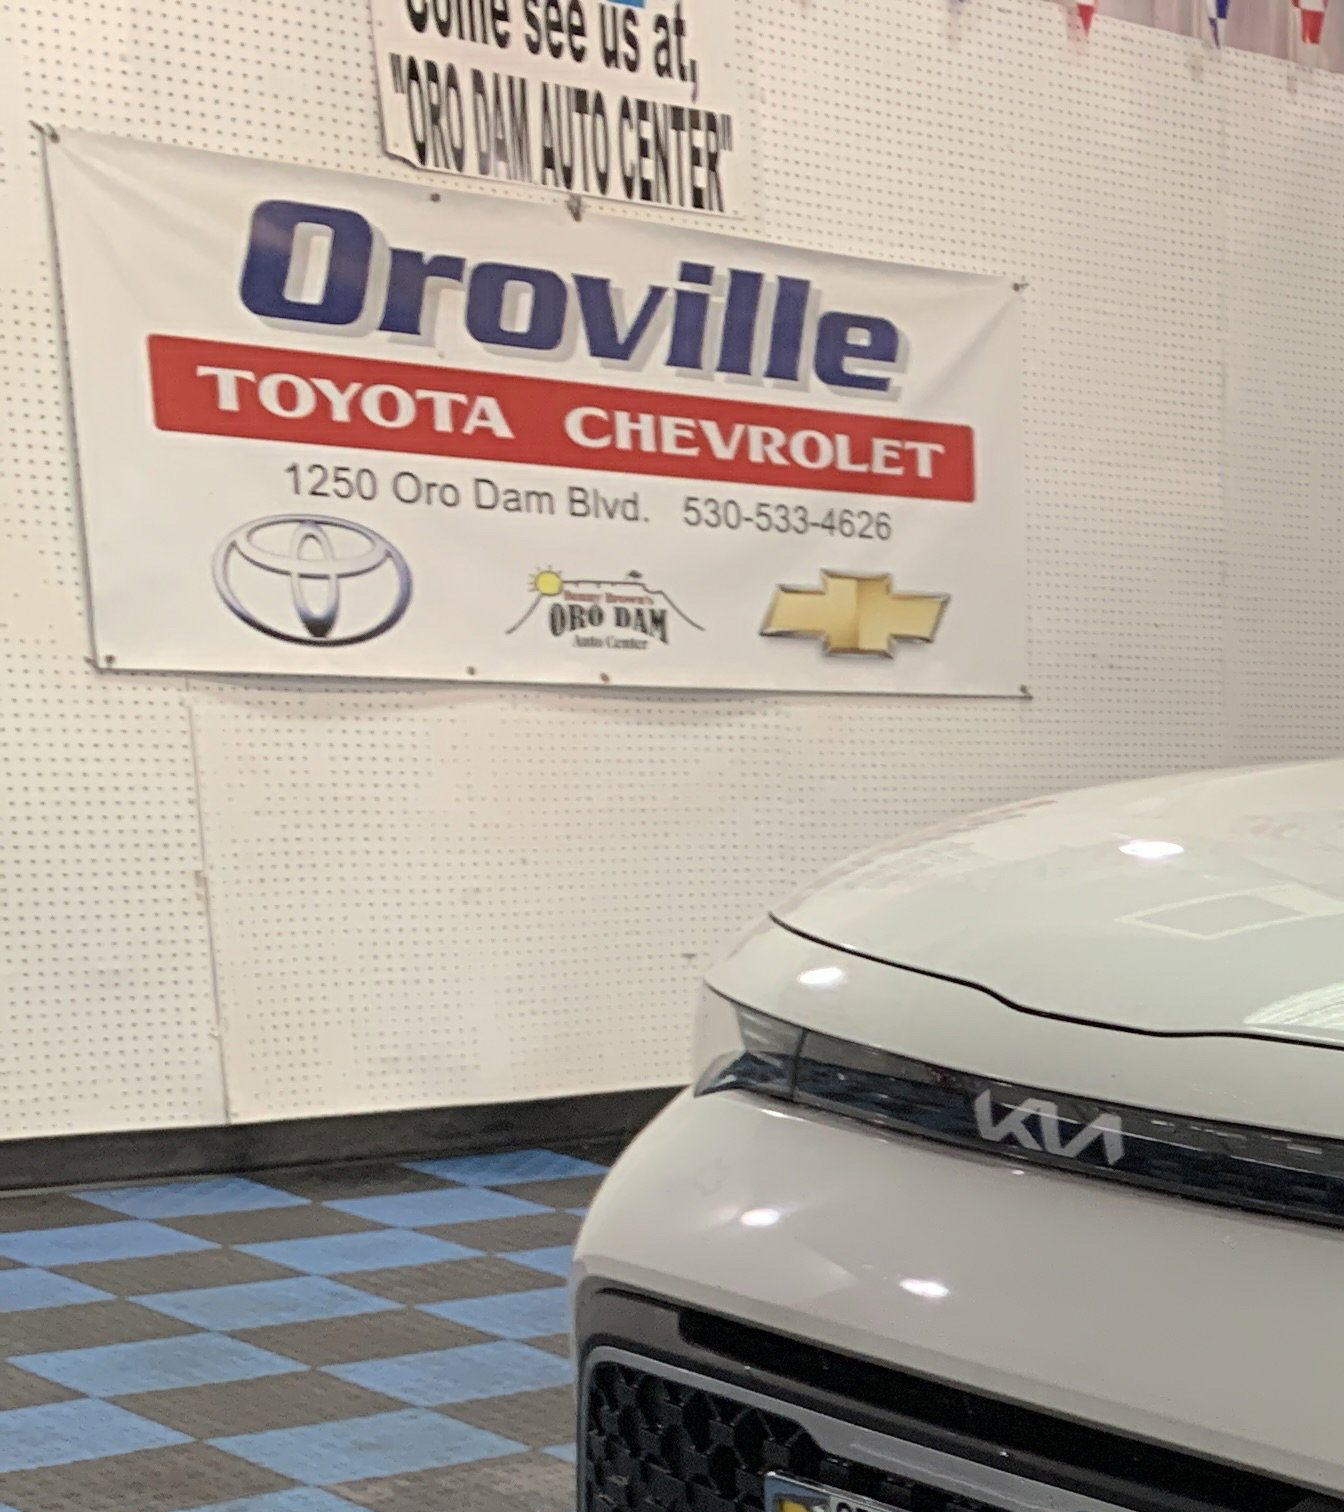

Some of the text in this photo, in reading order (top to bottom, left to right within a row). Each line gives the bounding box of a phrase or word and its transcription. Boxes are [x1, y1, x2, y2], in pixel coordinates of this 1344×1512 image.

[524, 0, 588, 63] see
[600, 4, 641, 73] us
[653, 1, 698, 104] at,
[471, 67, 532, 185] DAM
[541, 80, 610, 196] AUTO
[239, 199, 904, 396] Oroville
[196, 364, 945, 479] TOYOTA CHEVROLET
[285, 461, 893, 542] 1250 Oro Dam Blvd. 530-533-4626
[550, 602, 669, 645] ORO DAM
[573, 634, 649, 650] Auto Center
